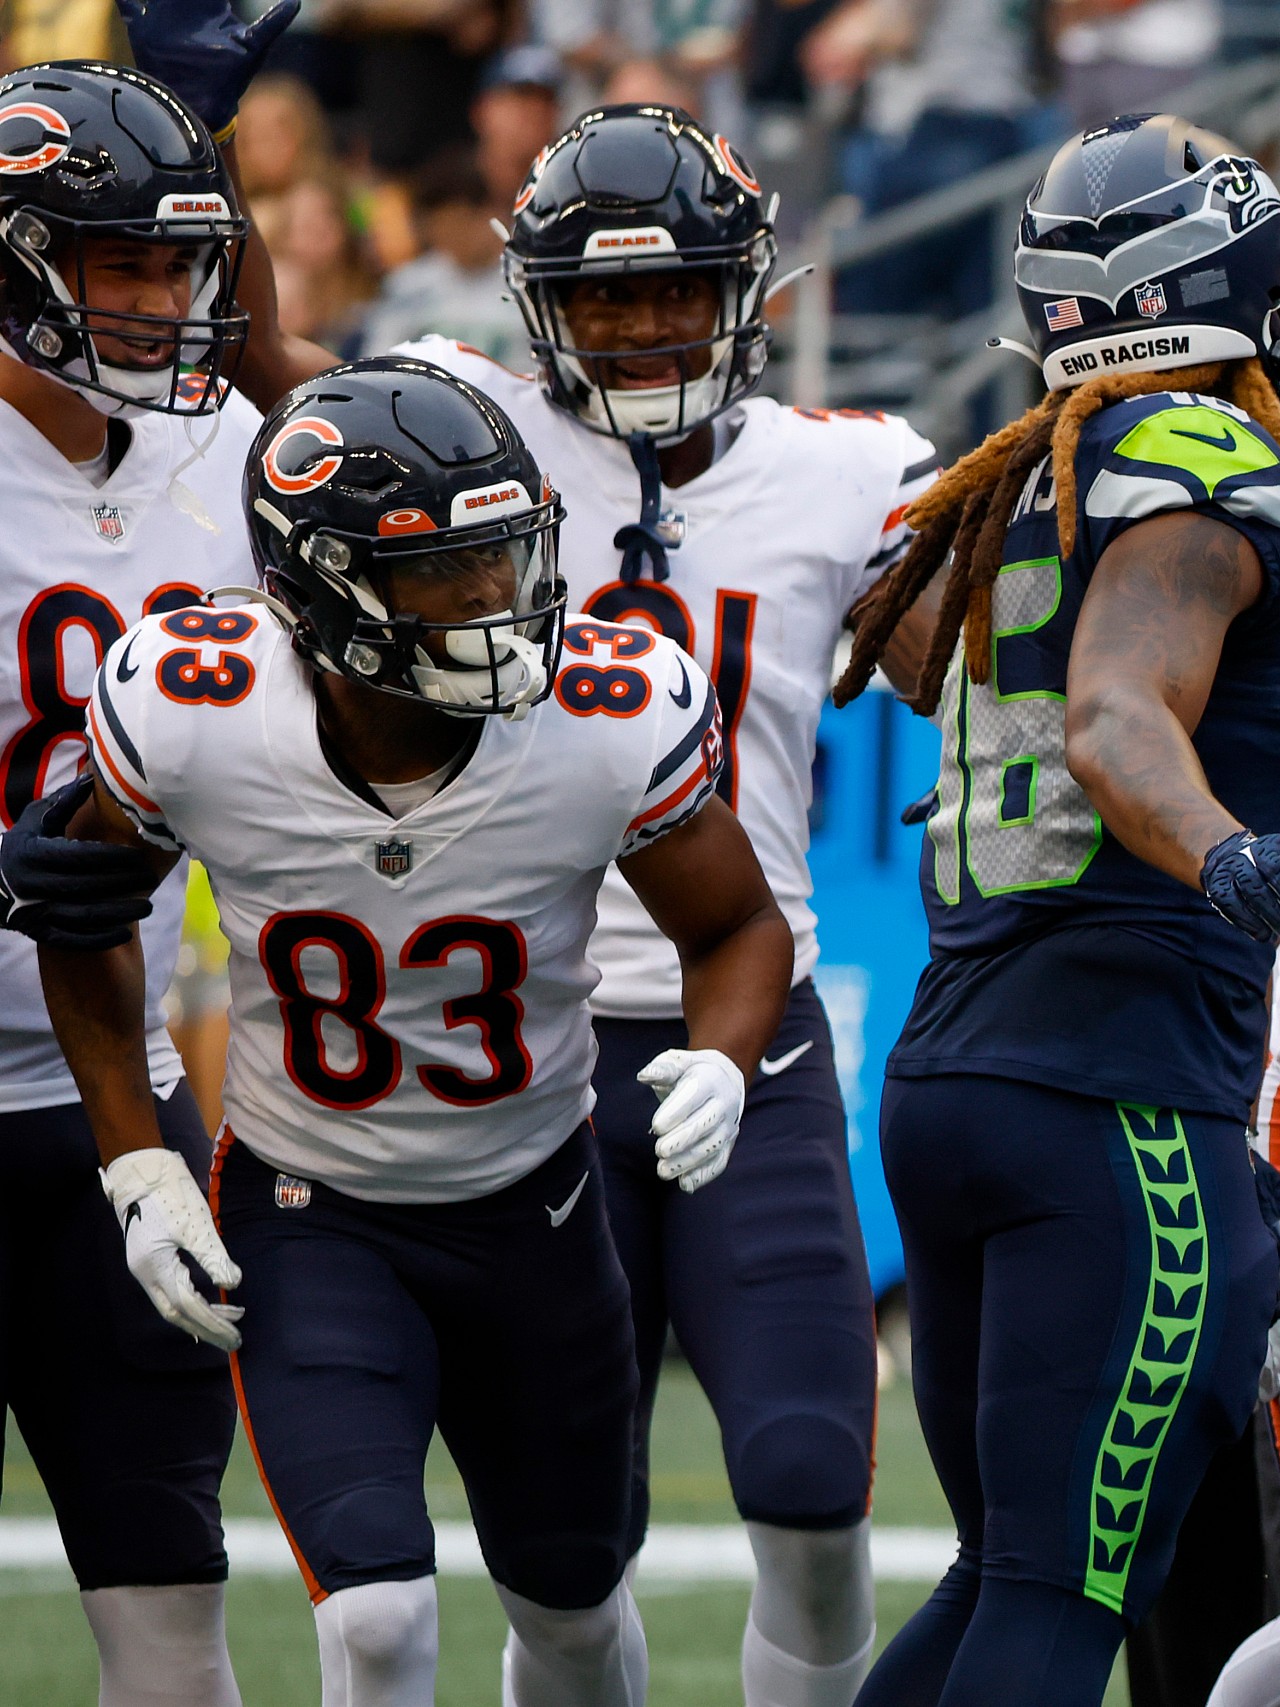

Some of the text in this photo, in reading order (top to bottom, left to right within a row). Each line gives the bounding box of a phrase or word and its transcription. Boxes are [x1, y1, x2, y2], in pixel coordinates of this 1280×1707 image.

[172, 202, 222, 213] BEARS
[597, 236, 660, 248] BEARS
[1141, 298, 1163, 314] NFL
[1060, 336, 1190, 376] END RACISM
[262, 416, 344, 495] C
[464, 488, 519, 510] BEARS
[155, 609, 259, 708] 83
[554, 622, 656, 719] 83
[382, 857, 407, 871] NFL
[258, 910, 533, 1112] 83
[281, 1186, 305, 1204] NFL
